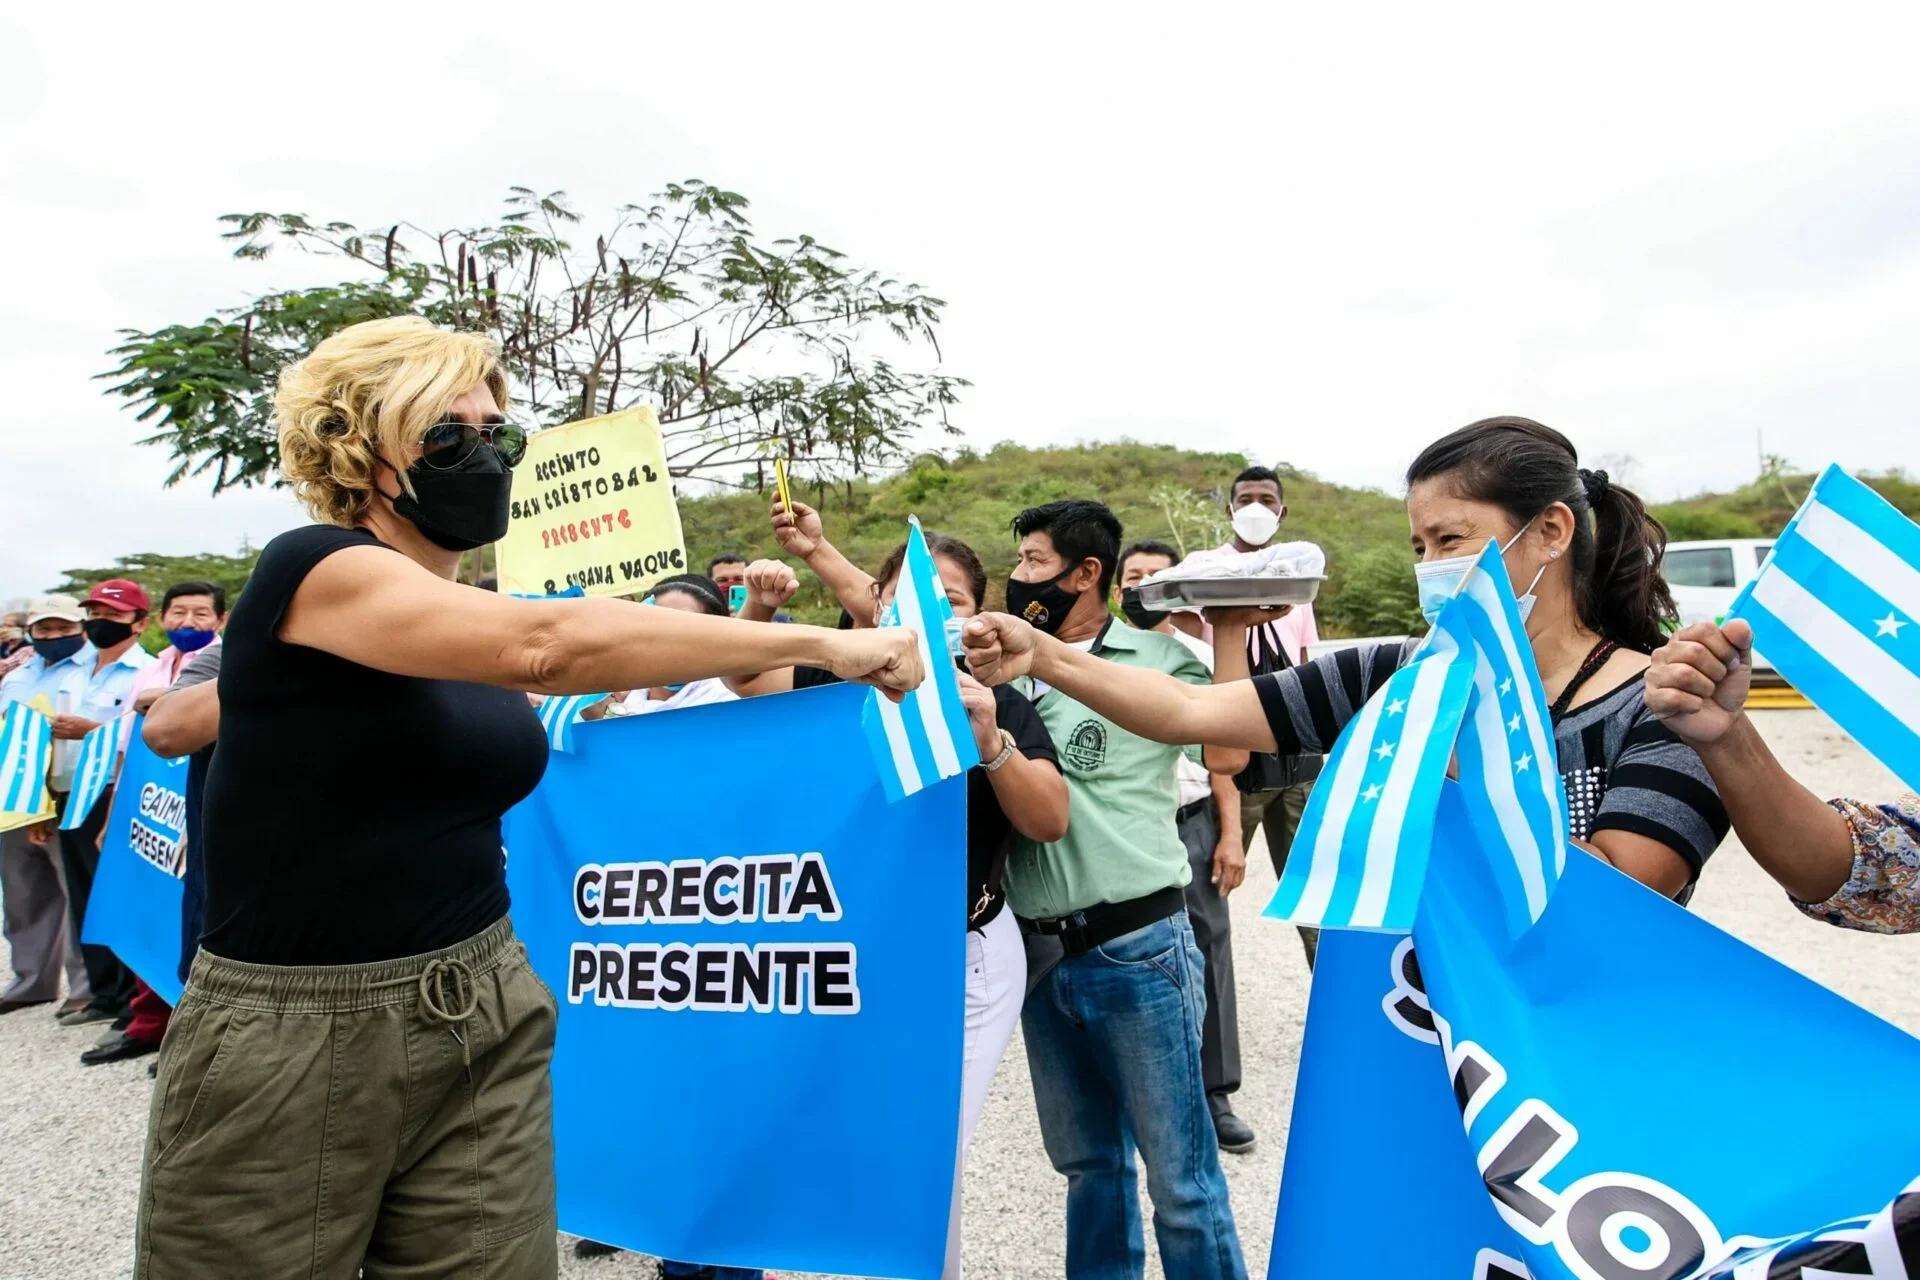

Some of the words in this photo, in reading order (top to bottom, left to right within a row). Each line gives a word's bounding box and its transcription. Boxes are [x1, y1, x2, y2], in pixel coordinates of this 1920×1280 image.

[511, 496, 541, 519] SAN
[541, 508, 632, 549] PRESENTE
[575, 857, 839, 922] CERECITA
[570, 945, 857, 1010] PRESENTE
